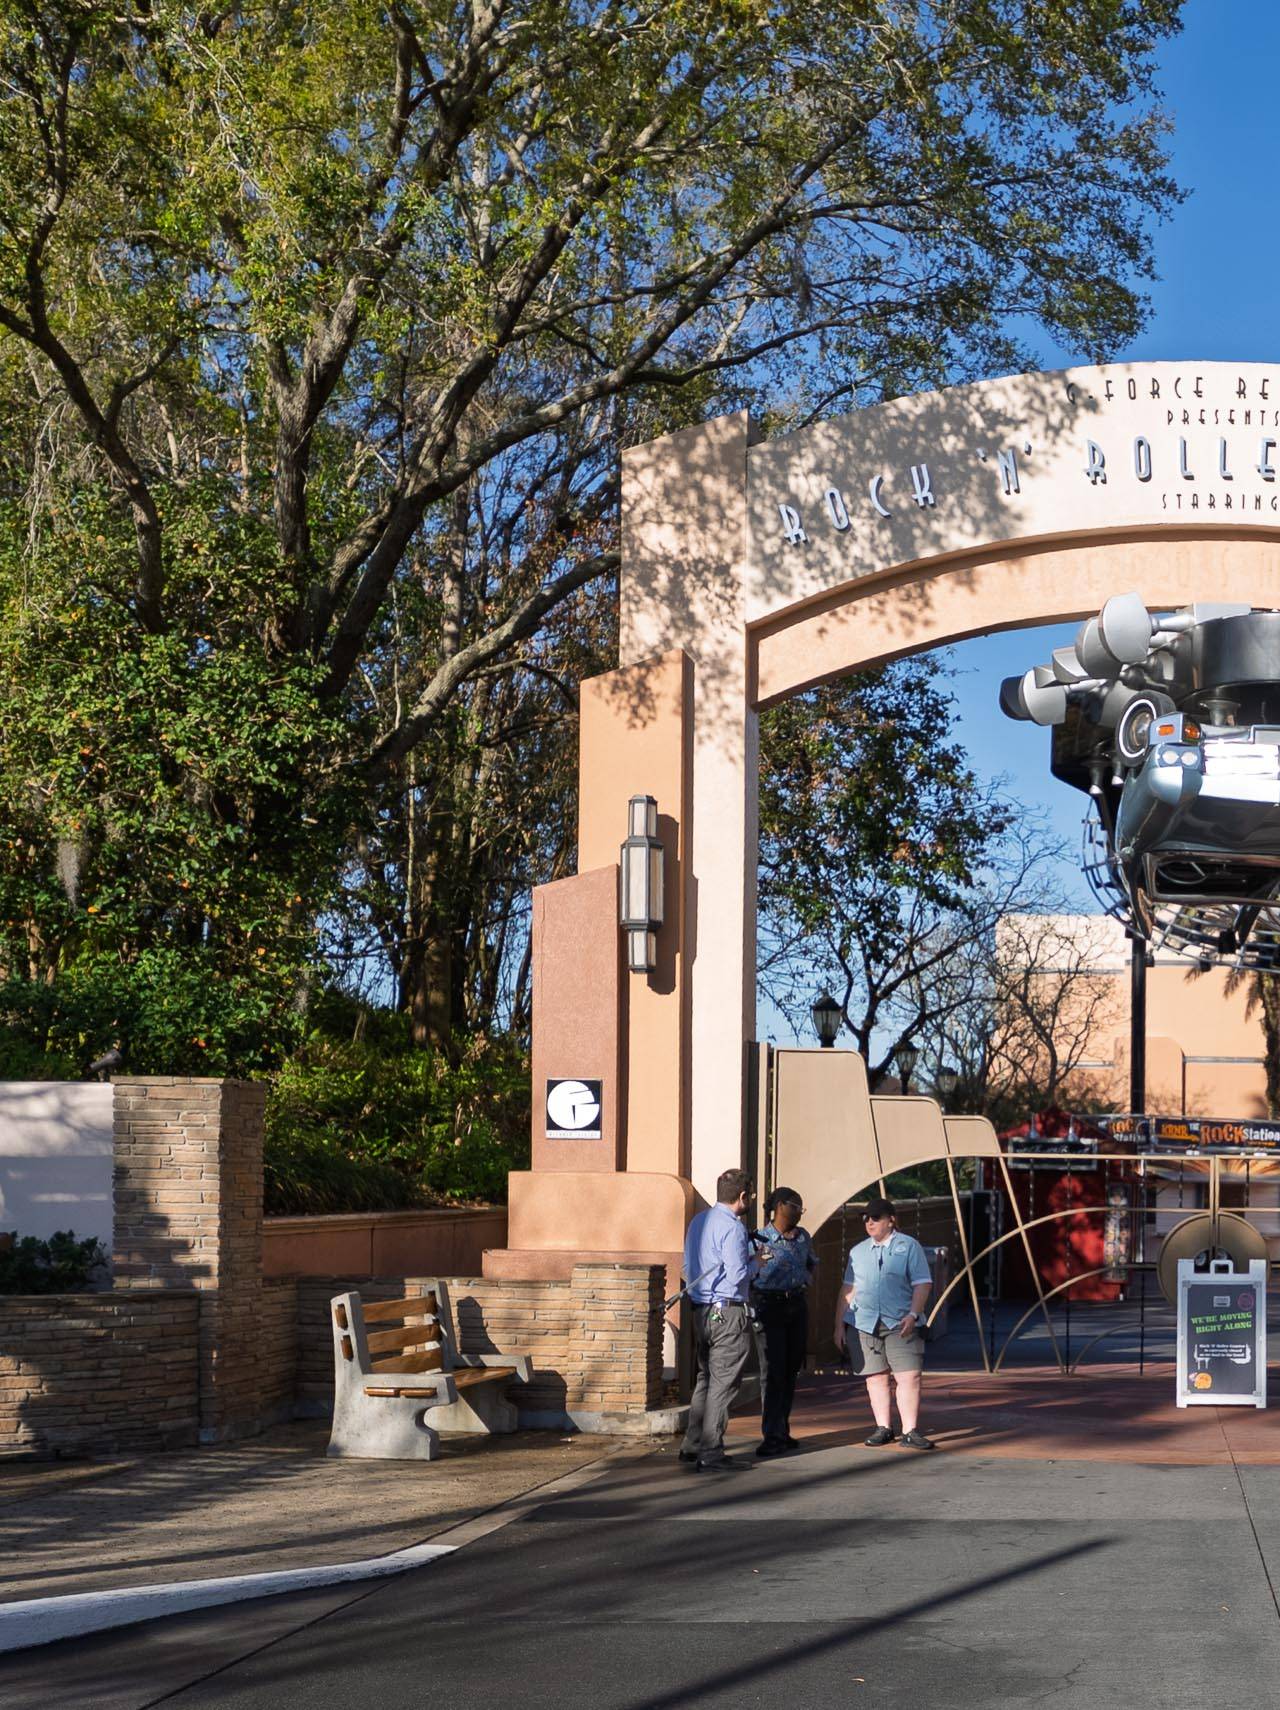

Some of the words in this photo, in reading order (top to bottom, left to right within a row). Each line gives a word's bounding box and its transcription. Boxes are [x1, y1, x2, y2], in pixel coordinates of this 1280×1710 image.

[1167, 408, 1280, 427] PRESENTS
[778, 463, 938, 546] ROCK
[1162, 492, 1280, 512] STARRING
[1220, 1311, 1252, 1322] MOVING
[1195, 1324, 1222, 1334] RIGHT
[1224, 1320, 1252, 1331] ALONG
